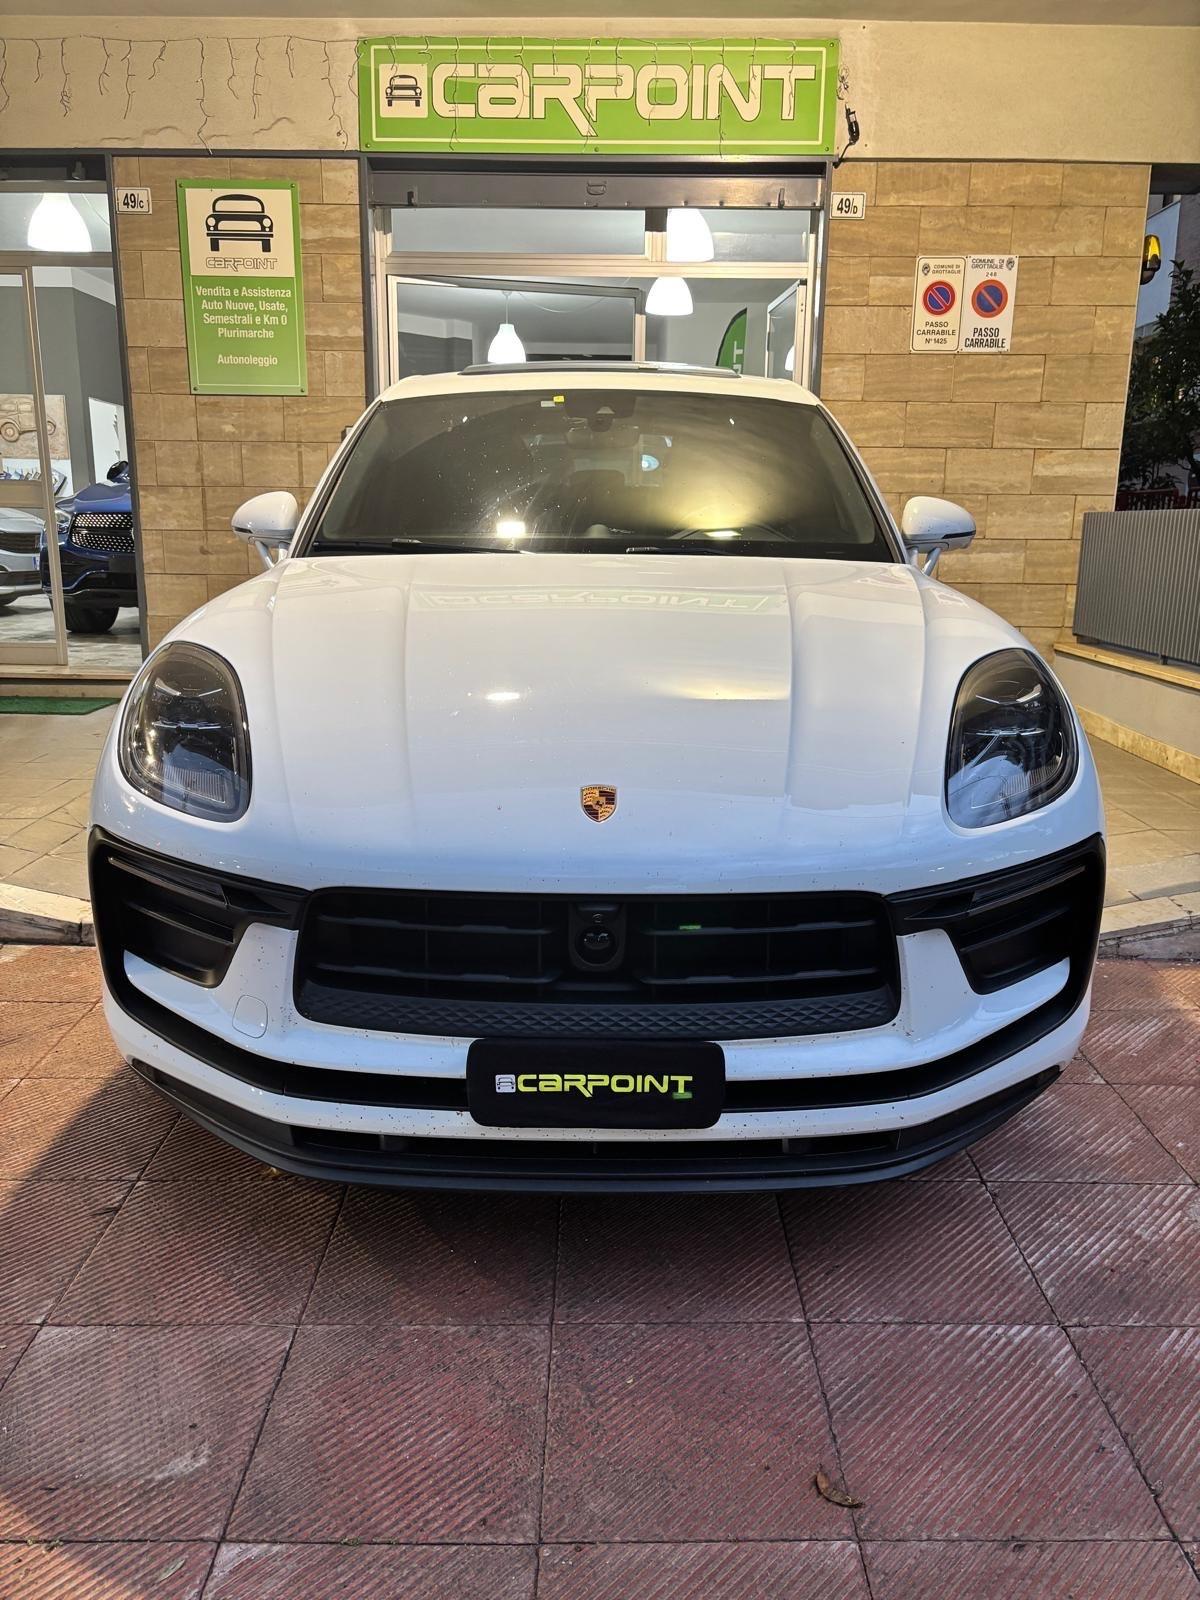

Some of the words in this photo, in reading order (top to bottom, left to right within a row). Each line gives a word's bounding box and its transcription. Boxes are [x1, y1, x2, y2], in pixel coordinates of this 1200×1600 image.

[195, 286, 231, 297] Vendita
[233, 288, 239, 296] e
[241, 287, 292, 298] Assistenza
[201, 299, 223, 310] Auto
[225, 300, 257, 312] Nuove,
[259, 301, 289, 313] Usate,
[203, 313, 253, 325] Semestrali
[255, 316, 261, 325] e
[263, 314, 279, 325] Km
[218, 327, 274, 338] Plurimarche
[973, 327, 1000, 338] PASSO
[964, 337, 1006, 349] CARRABILE
[217, 354, 278, 367] Autonoleggio
